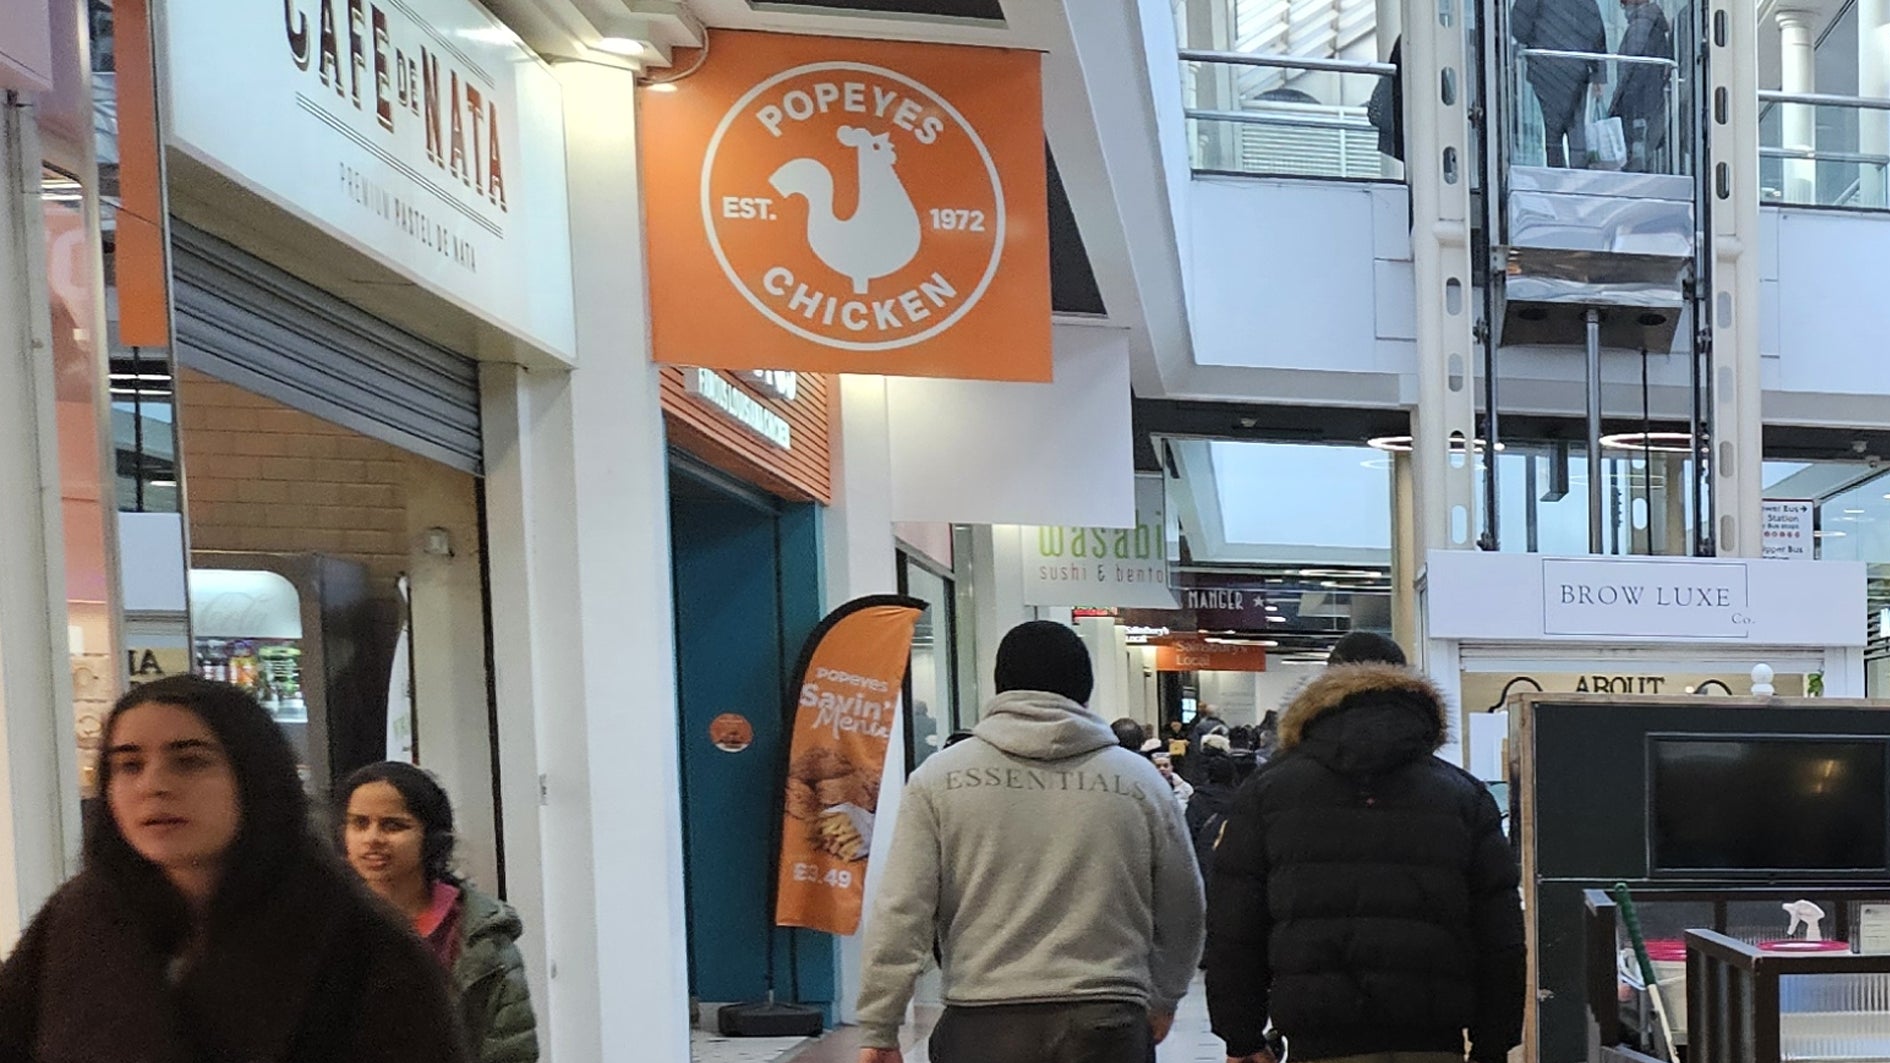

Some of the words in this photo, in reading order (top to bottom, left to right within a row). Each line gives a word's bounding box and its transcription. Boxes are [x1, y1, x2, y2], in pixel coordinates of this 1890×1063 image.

[755, 81, 945, 145] POPEYES
[396, 47, 419, 118] DE
[420, 44, 507, 213] NATA
[339, 161, 390, 221] PREMIUM
[394, 197, 433, 248] PASTEL
[436, 223, 449, 258] DE
[452, 233, 477, 274] NATA
[722, 196, 777, 221] EST.
[930, 207, 985, 233] 1972
[762, 266, 957, 331] CHICKEN
[1767, 514, 1800, 522] Station
[1783, 505, 1799, 513] Bus
[1038, 509, 1164, 560] wasabi
[1788, 545, 1803, 553] Bus
[1039, 563, 1087, 582] sushi
[1097, 564, 1106, 583] &
[1116, 564, 1164, 584] bento
[1187, 590, 1244, 610] MANGER
[1560, 584, 1645, 606] BROW
[1656, 586, 1731, 607] LUXE
[1731, 613, 1755, 625] Co.
[1575, 675, 1666, 695] ABOUT
[799, 682, 892, 721] Savin'
[945, 767, 1147, 801] ESSENTIALS
